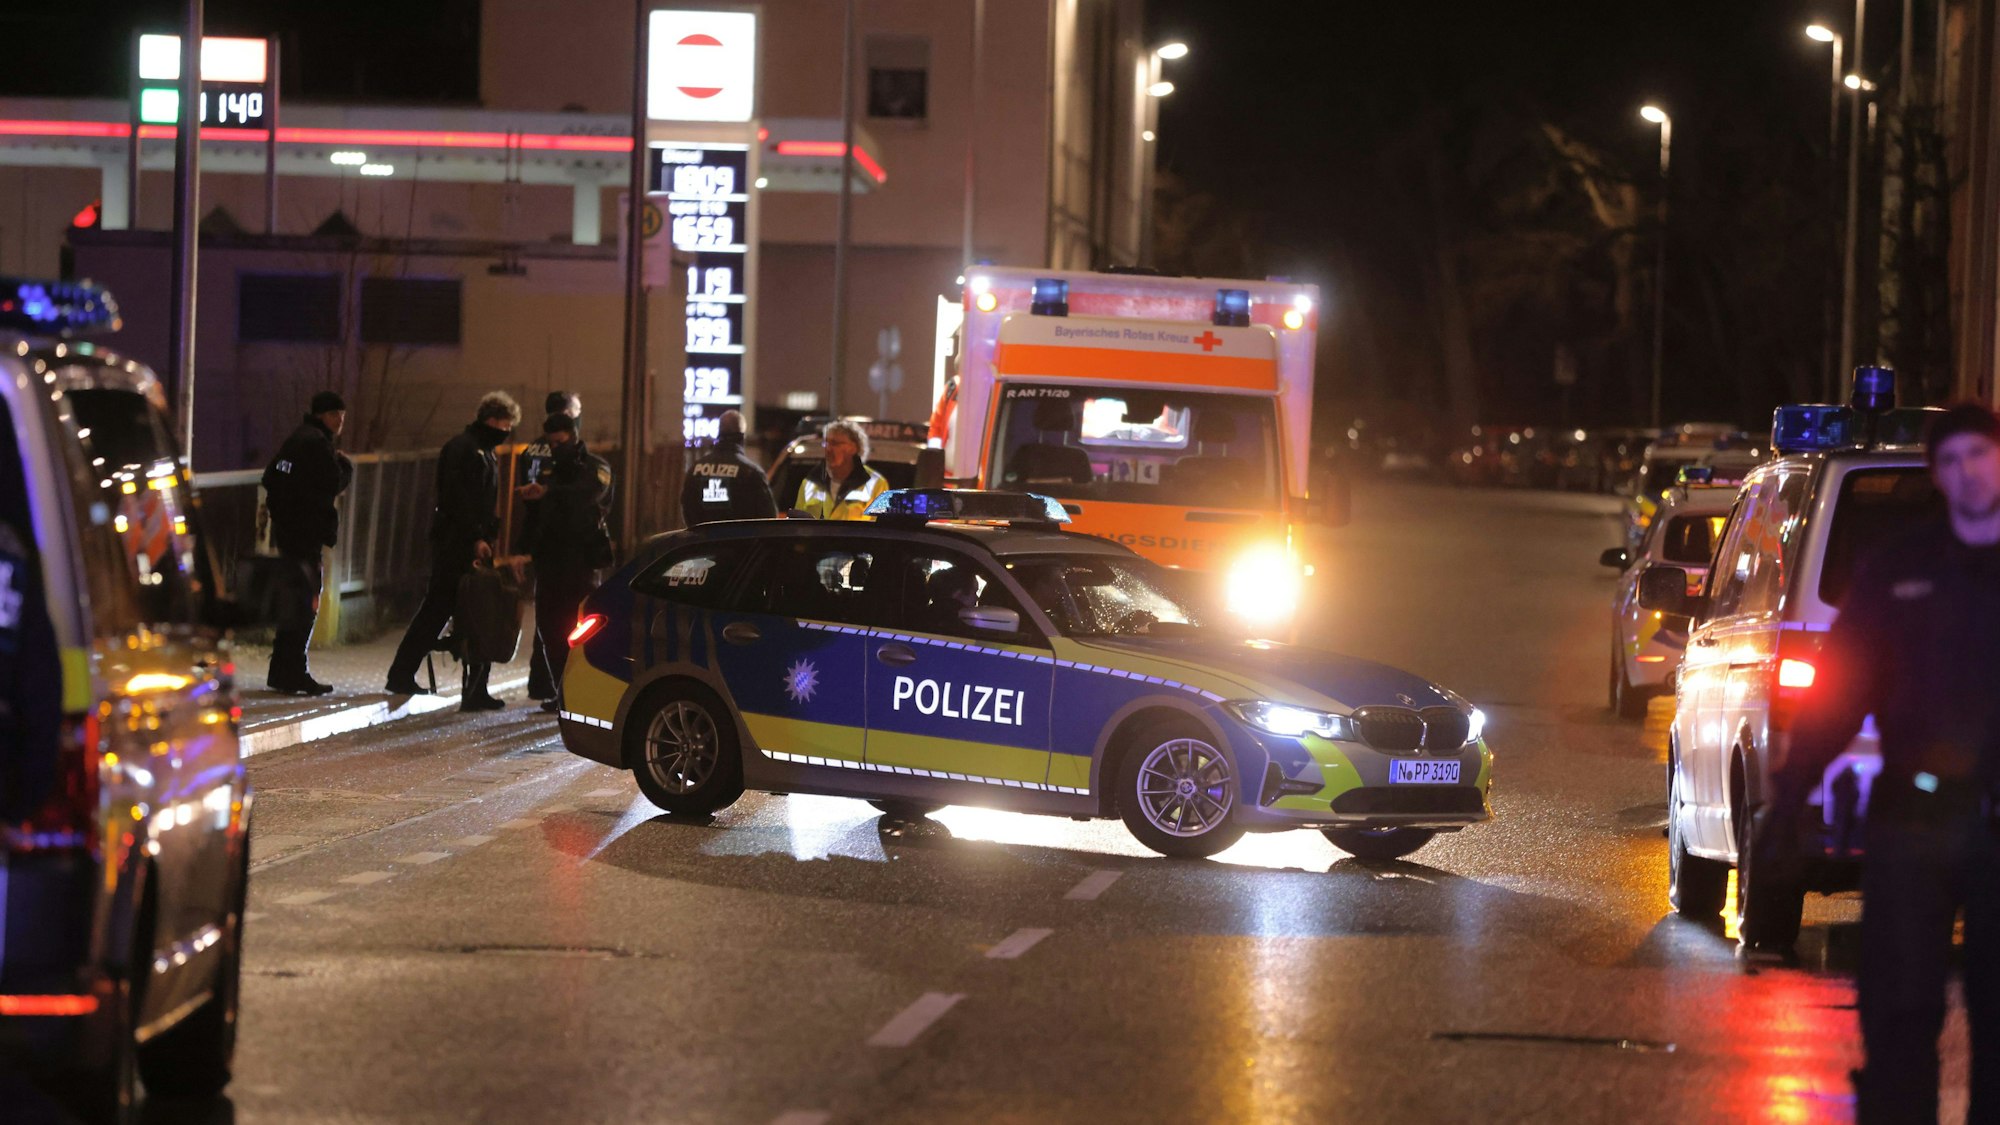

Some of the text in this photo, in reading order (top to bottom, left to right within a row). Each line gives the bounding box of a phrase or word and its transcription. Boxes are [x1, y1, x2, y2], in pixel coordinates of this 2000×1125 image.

[1055, 325, 1189, 343] Bayerisches Rotes Kreuz
[1007, 389, 1016, 398] R
[1018, 389, 1036, 397] AN
[693, 463, 739, 478] POLIZEI
[893, 675, 1025, 726] POLIZEI
[1414, 763, 1430, 780] PP
[1431, 763, 1458, 780] 3190
